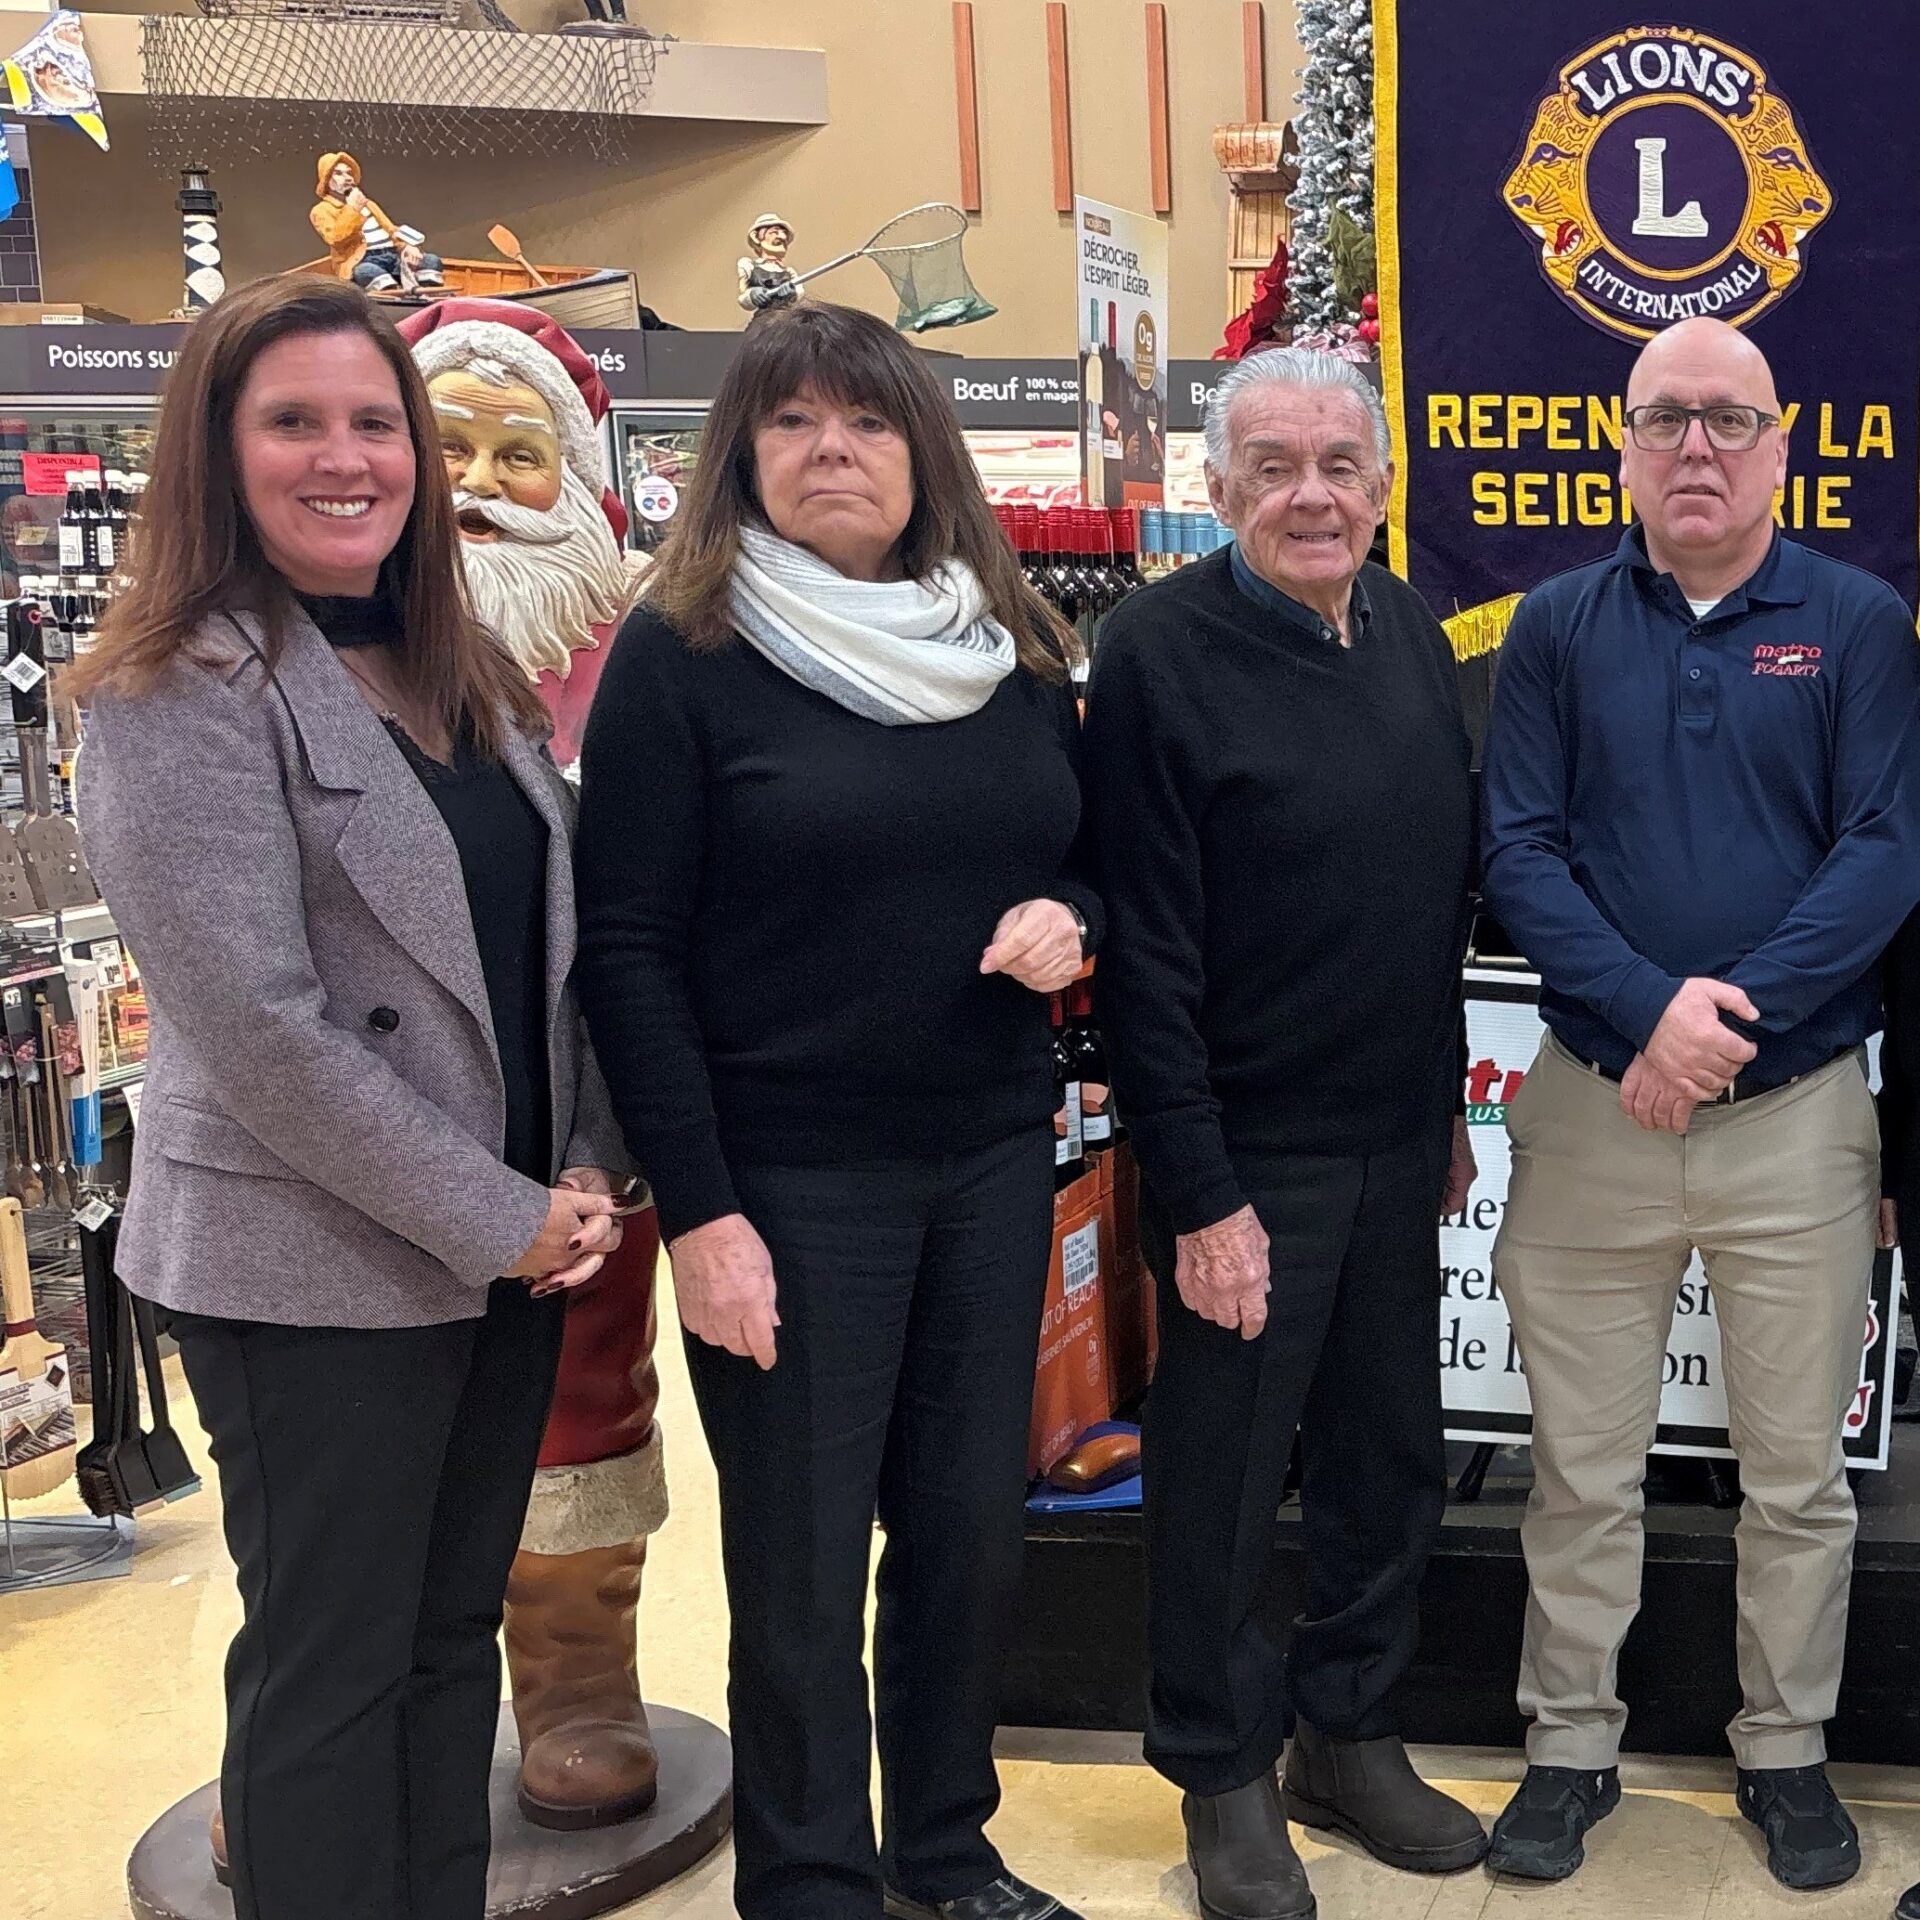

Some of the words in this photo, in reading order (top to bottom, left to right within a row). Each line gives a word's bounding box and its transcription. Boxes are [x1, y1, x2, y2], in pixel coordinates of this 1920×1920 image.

[1570, 43, 1750, 111] LIONS
[1632, 137, 1709, 238] L
[1083, 235, 1141, 275] DÉCROCHER,
[1084, 263, 1119, 289] L'ESPRIT
[1122, 270, 1152, 298] LÉGER.
[1578, 258, 1761, 320] INTERNATIONAL
[48, 344, 144, 369] Poissons
[953, 376, 1019, 400] Bœuf
[1025, 391, 1041, 401] en
[1818, 402, 1895, 459] LA
[1754, 643, 1822, 659] metro
[1751, 661, 1821, 678] FOGARTY
[1466, 1106, 1505, 1122] LUS
[1041, 1309, 1054, 1336] UT
[1054, 1298, 1067, 1325] OF
[1067, 1277, 1098, 1315] REACH
